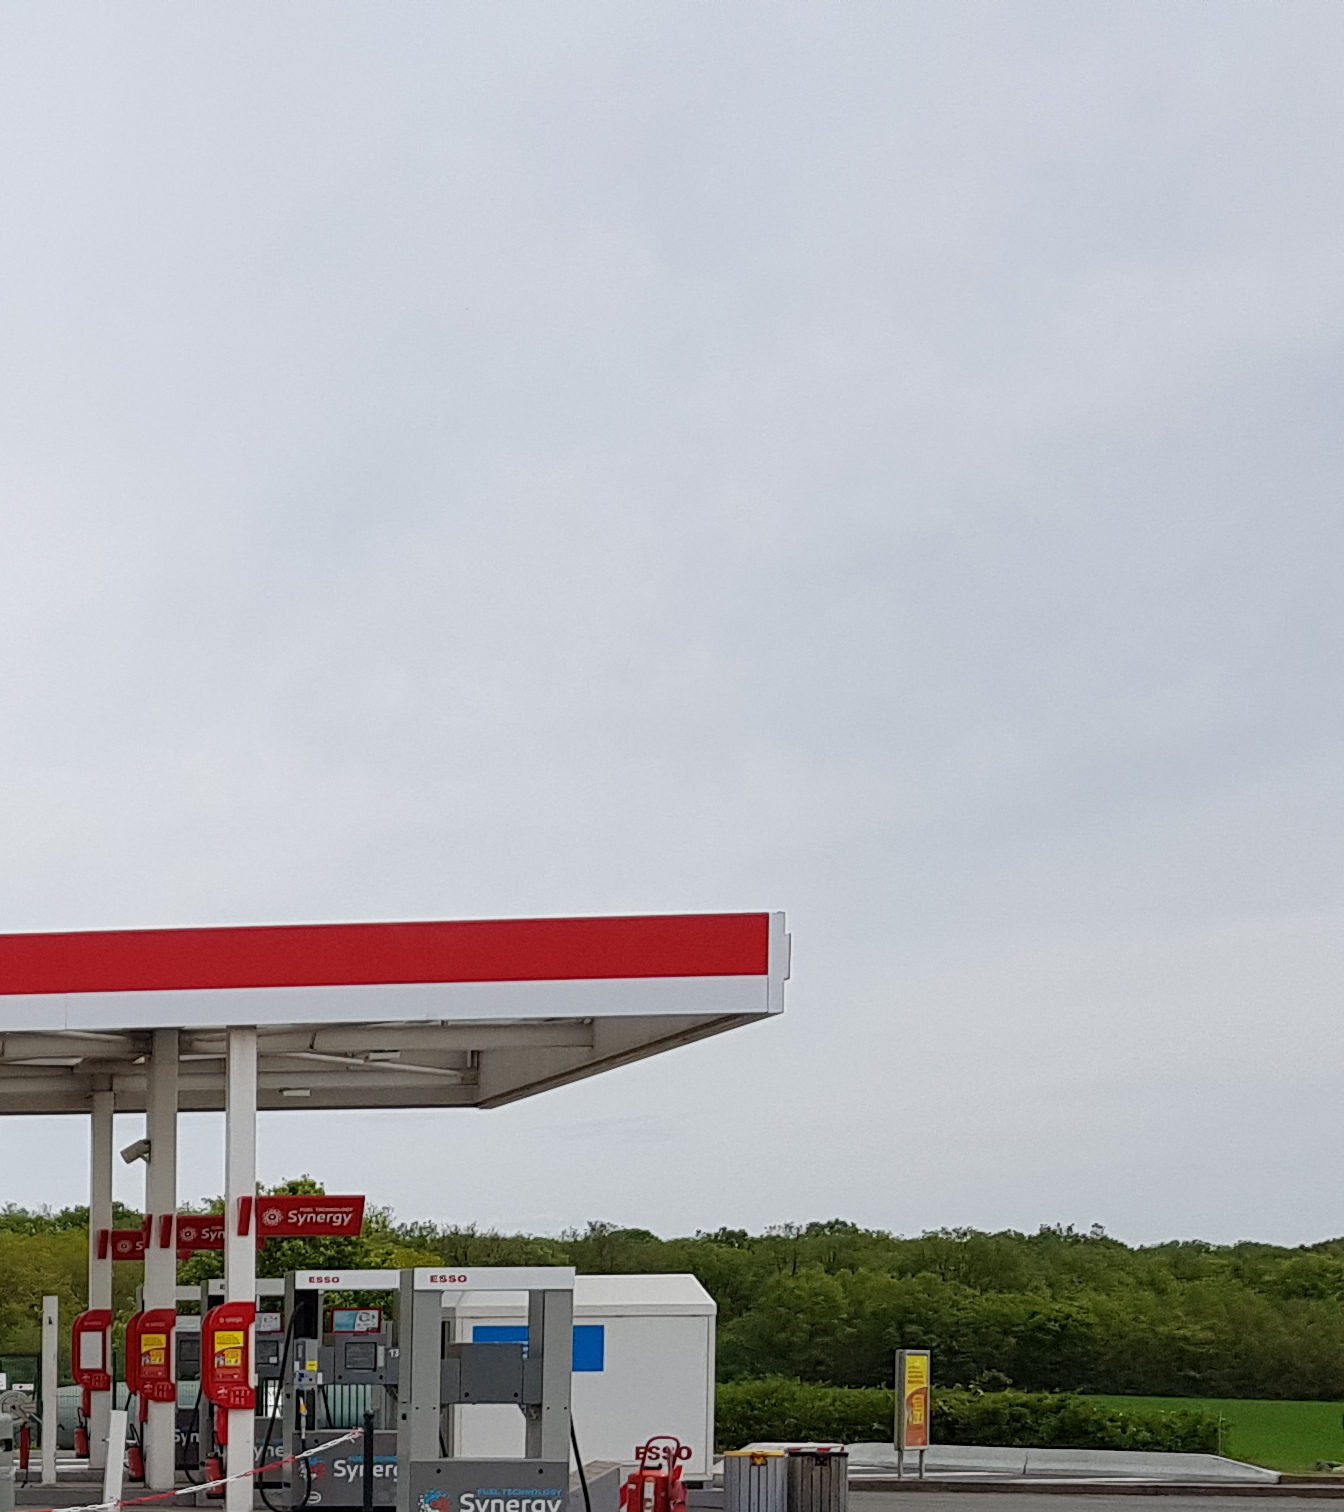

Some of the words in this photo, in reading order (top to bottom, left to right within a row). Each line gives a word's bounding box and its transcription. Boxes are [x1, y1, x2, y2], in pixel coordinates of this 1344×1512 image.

[287, 1210, 353, 1226] Synergy
[429, 1275, 467, 1283] ESSO
[502, 1488, 562, 1496] TECHNOLOGY
